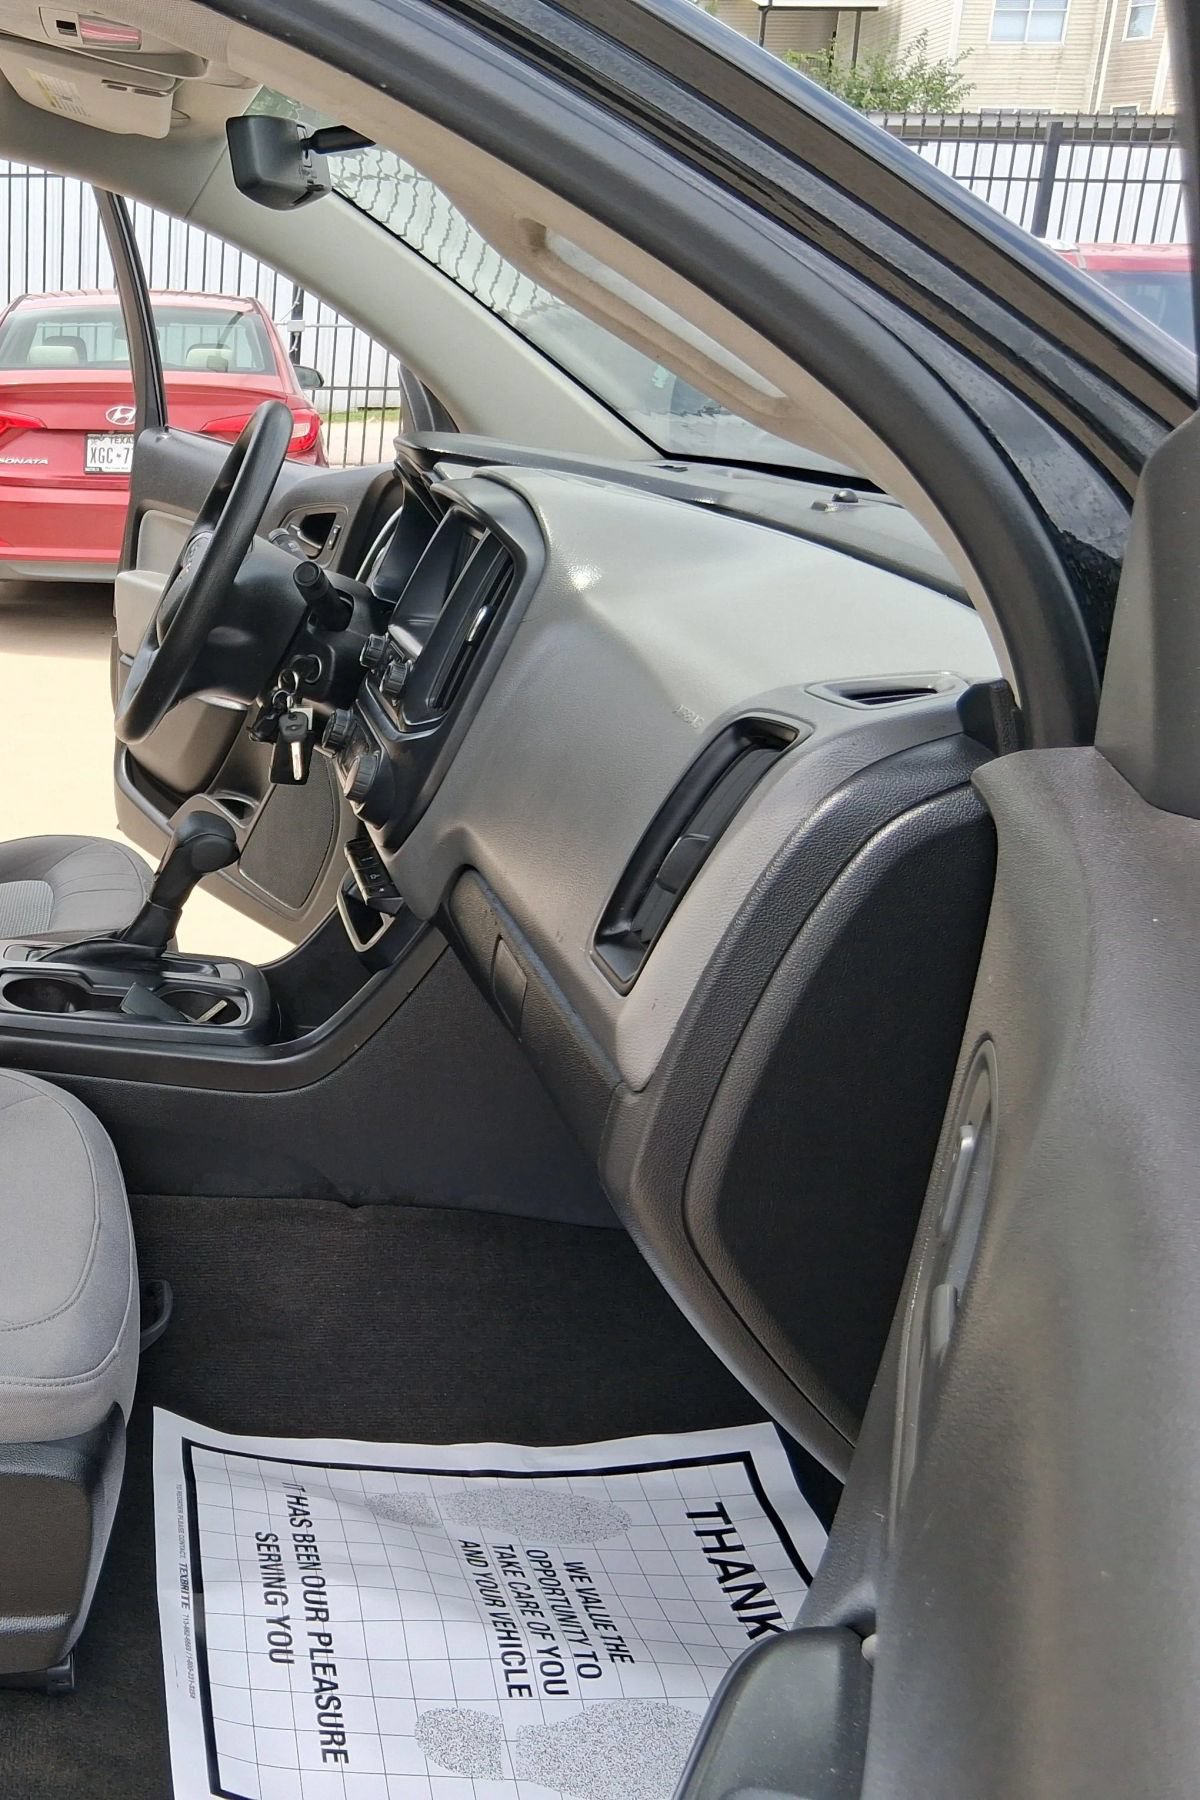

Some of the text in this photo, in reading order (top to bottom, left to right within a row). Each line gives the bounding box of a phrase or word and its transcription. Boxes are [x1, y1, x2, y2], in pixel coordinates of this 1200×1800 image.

[110, 437, 134, 445] TEXA
[177, 1515, 185, 1534] PLEASE
[179, 1562, 190, 1610] TEXBRITE
[685, 1501, 787, 1640] THANK
[255, 1531, 295, 1664] SERVING YOU
[281, 1481, 349, 1764] IT HAS BEEN OUR PLEASURE
[458, 1539, 533, 1698] AND YOUR VEHICLE
[492, 1544, 569, 1695] TAKE CARE OF YOU
[526, 1549, 602, 1679] OPPORTUNITY TO
[563, 1561, 635, 1664] WE VALUE THE
